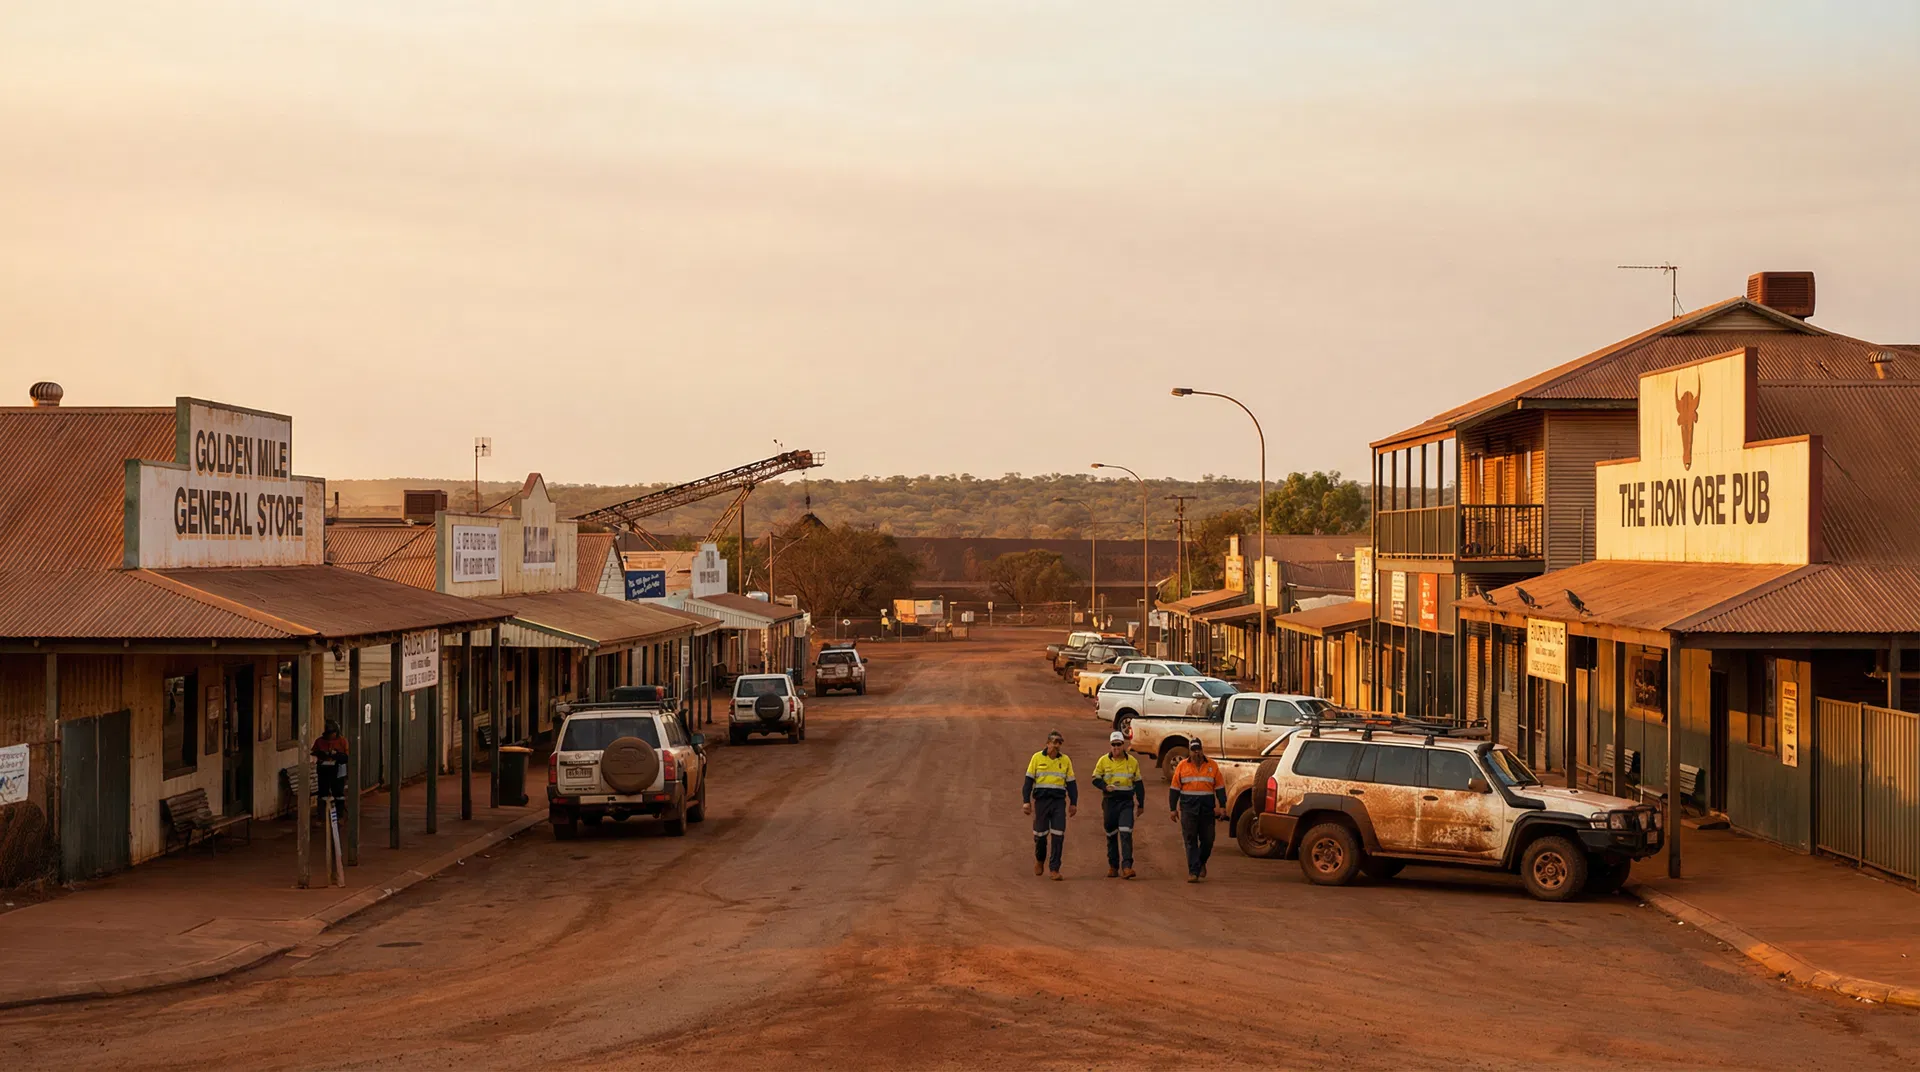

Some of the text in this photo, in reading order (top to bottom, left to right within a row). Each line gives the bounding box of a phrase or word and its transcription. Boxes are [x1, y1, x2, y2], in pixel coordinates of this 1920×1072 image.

[195, 429, 287, 479] GOLDEN MILE
[174, 486, 303, 537] GENERAL STORE
[1619, 470, 1770, 527] THE IRON ORE PUB
